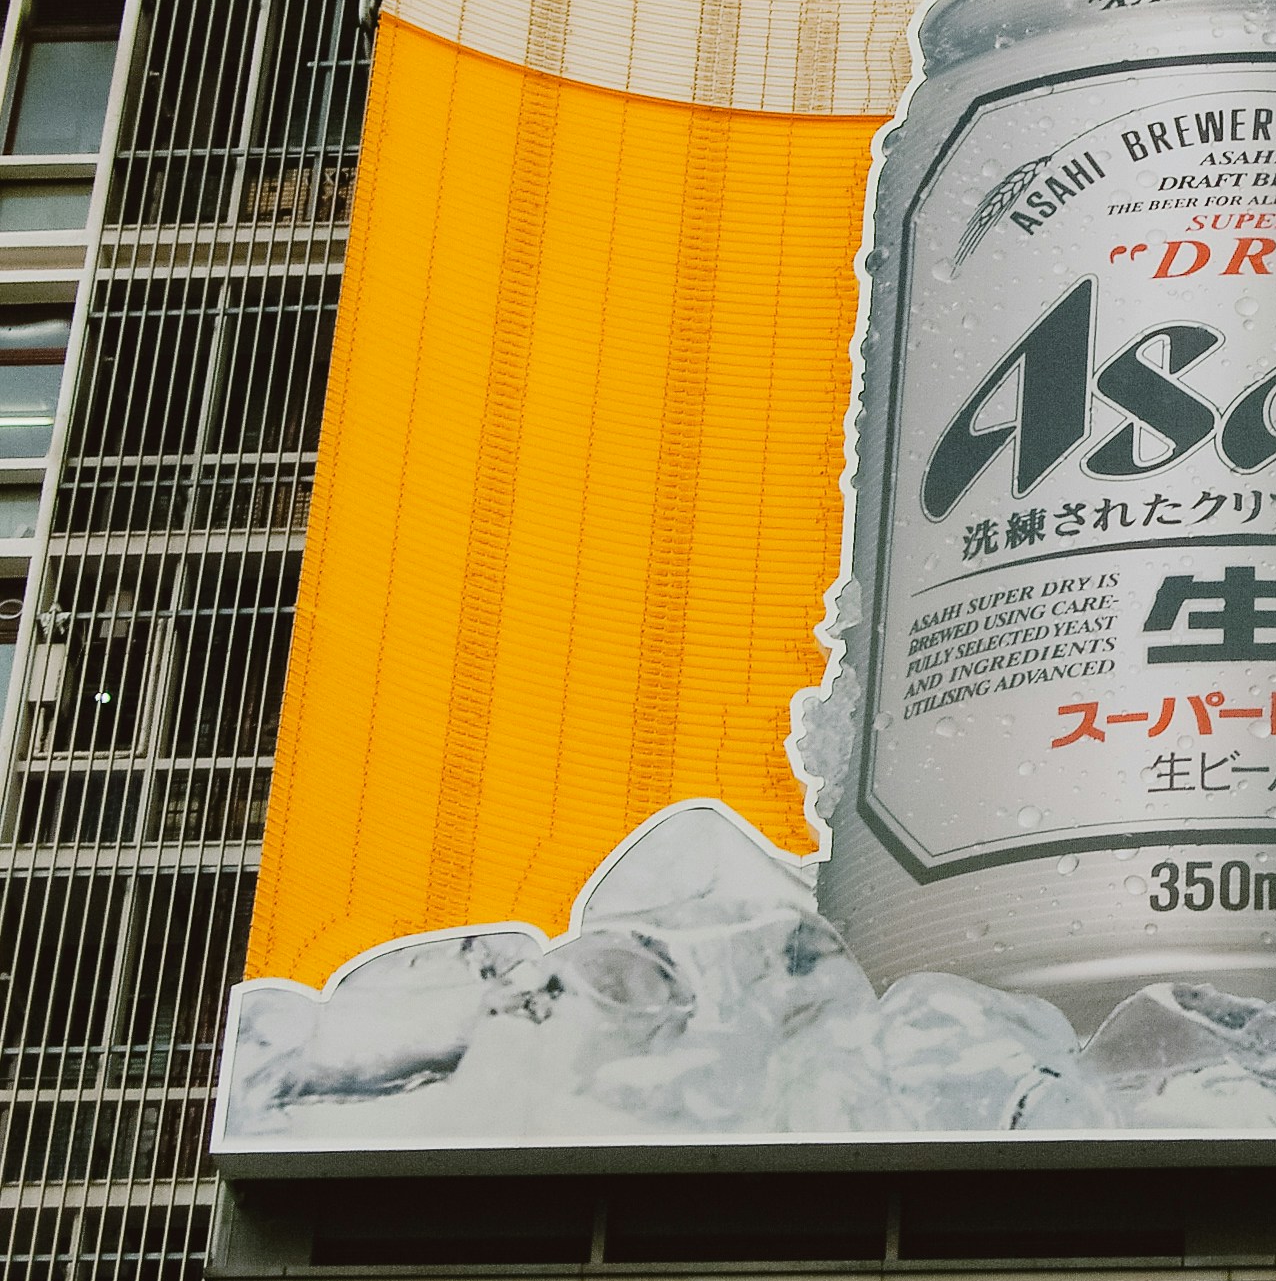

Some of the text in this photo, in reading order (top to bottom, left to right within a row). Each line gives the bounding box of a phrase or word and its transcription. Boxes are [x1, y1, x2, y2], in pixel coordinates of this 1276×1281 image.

[1010, 150, 1106, 237] ASAHI
[1107, 201, 1144, 216] THE
[1148, 197, 1199, 211] BEER
[1203, 195, 1243, 208] FOR
[1157, 172, 1248, 192] DRAFT
[907, 594, 1120, 656] BREWED USING CARE-
[908, 572, 1121, 636] ASAHI SUPER DRY IS
[903, 636, 1117, 700] AND INGREDIENTS
[906, 615, 1118, 678] FULLY SELECTED YEAST
[903, 659, 1116, 720] UTILISING ADVANCED
